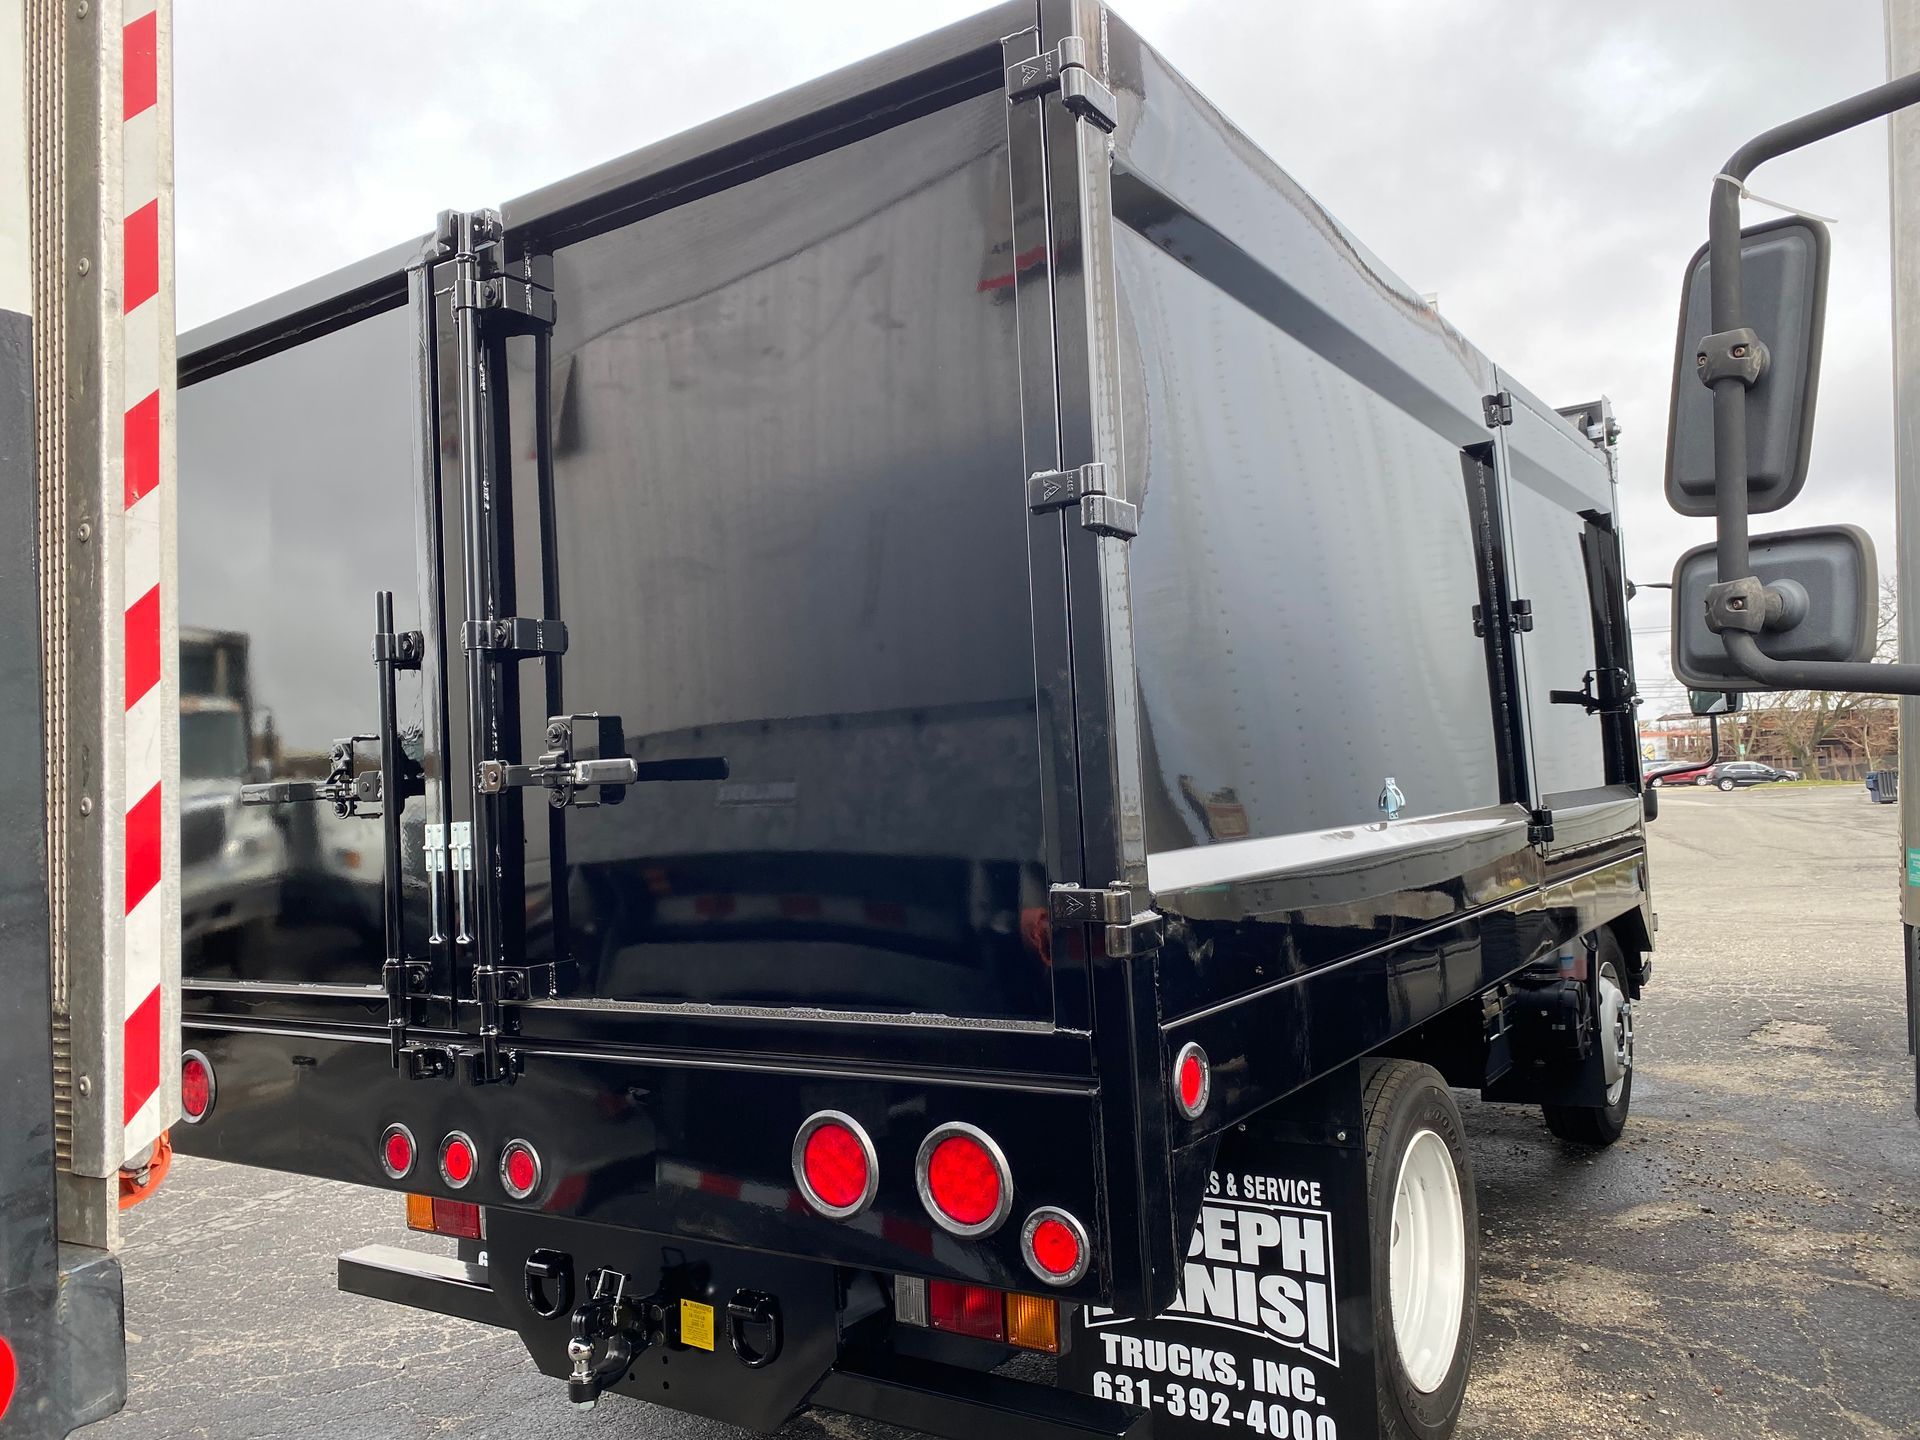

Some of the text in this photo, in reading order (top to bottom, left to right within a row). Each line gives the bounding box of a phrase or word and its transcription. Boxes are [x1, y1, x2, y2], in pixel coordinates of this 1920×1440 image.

[1204, 1170, 1322, 1206] S & SERVICE
[1167, 1263, 1330, 1352] NISI
[1100, 1332, 1327, 1406] TRUCKS, INC.
[1093, 1371, 1338, 1440] 631-392-4000
